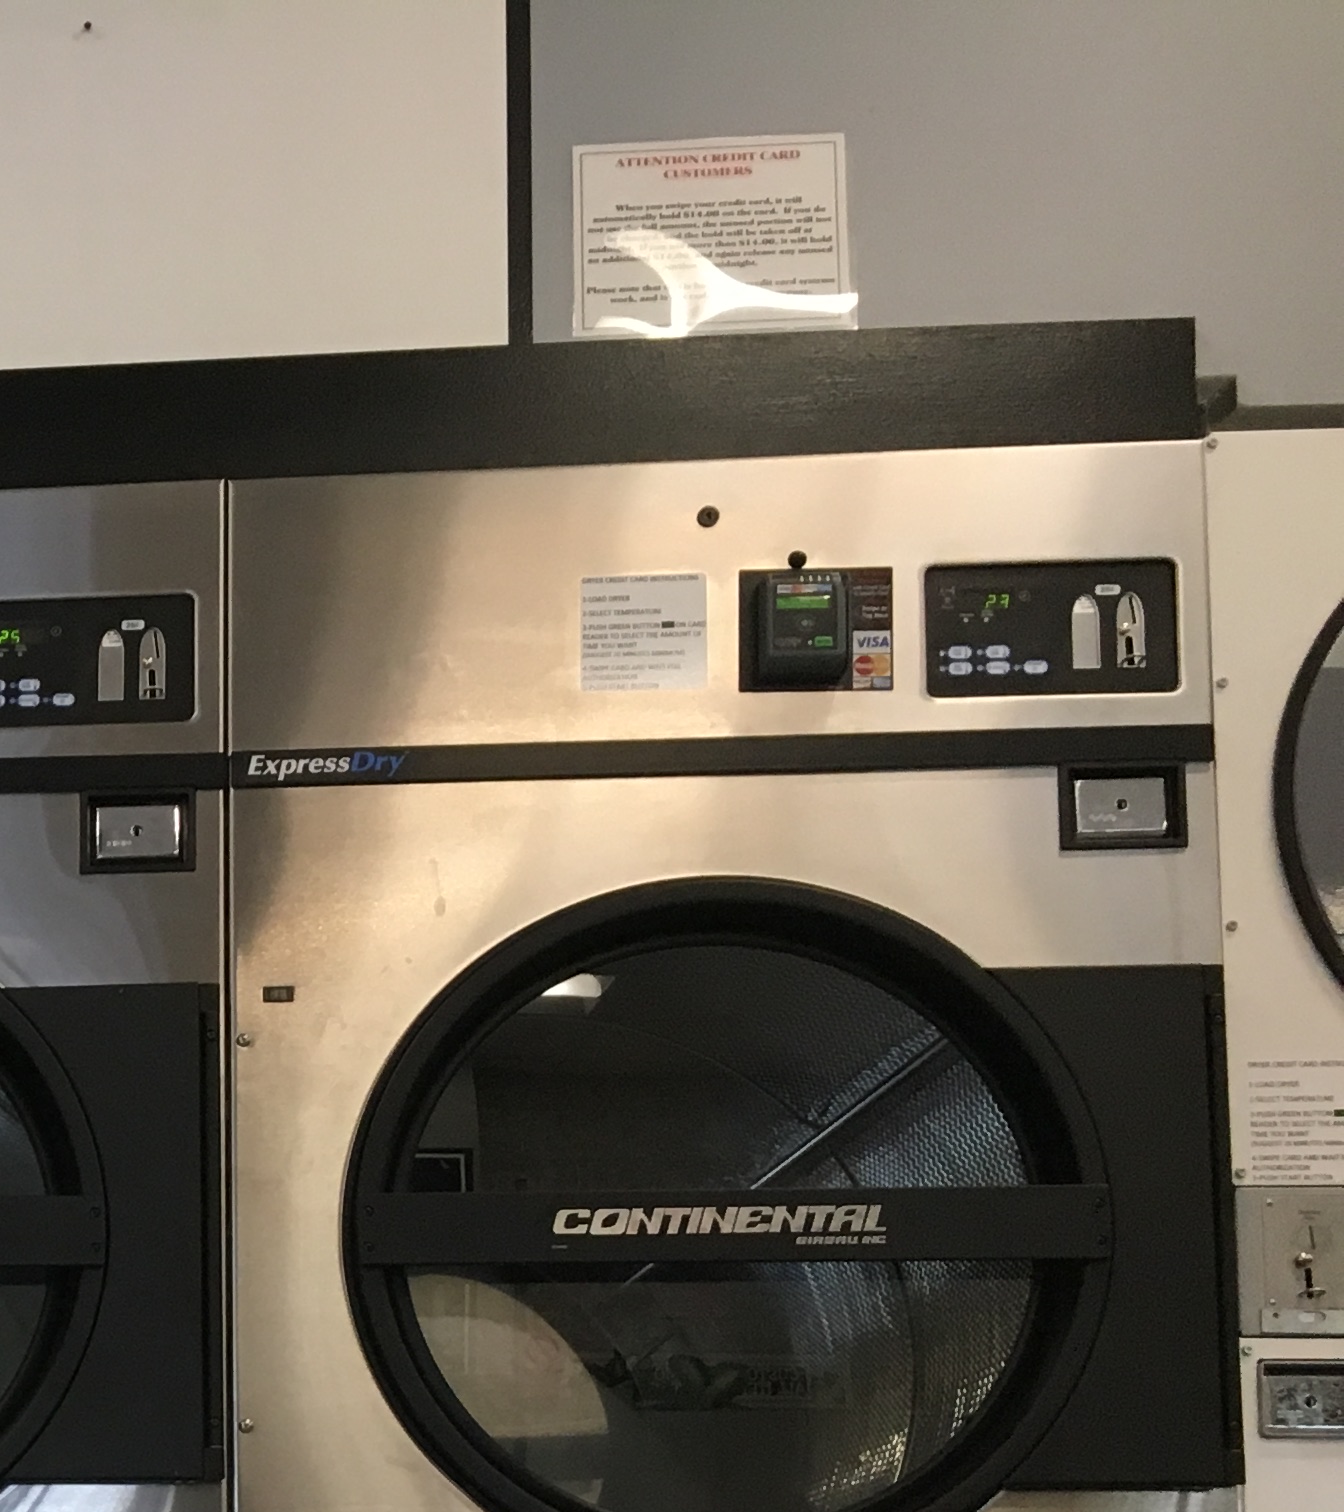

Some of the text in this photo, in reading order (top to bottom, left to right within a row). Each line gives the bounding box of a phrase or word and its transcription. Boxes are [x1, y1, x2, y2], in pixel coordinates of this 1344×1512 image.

[615, 150, 801, 168] ATTENTION CREDIT CARD
[663, 165, 753, 179] CUSTOMERS
[858, 636, 889, 647] VISA
[248, 750, 409, 780] ExpressDry
[552, 1204, 886, 1235] CONTINENTAL
[862, 1235, 886, 1244] INC
